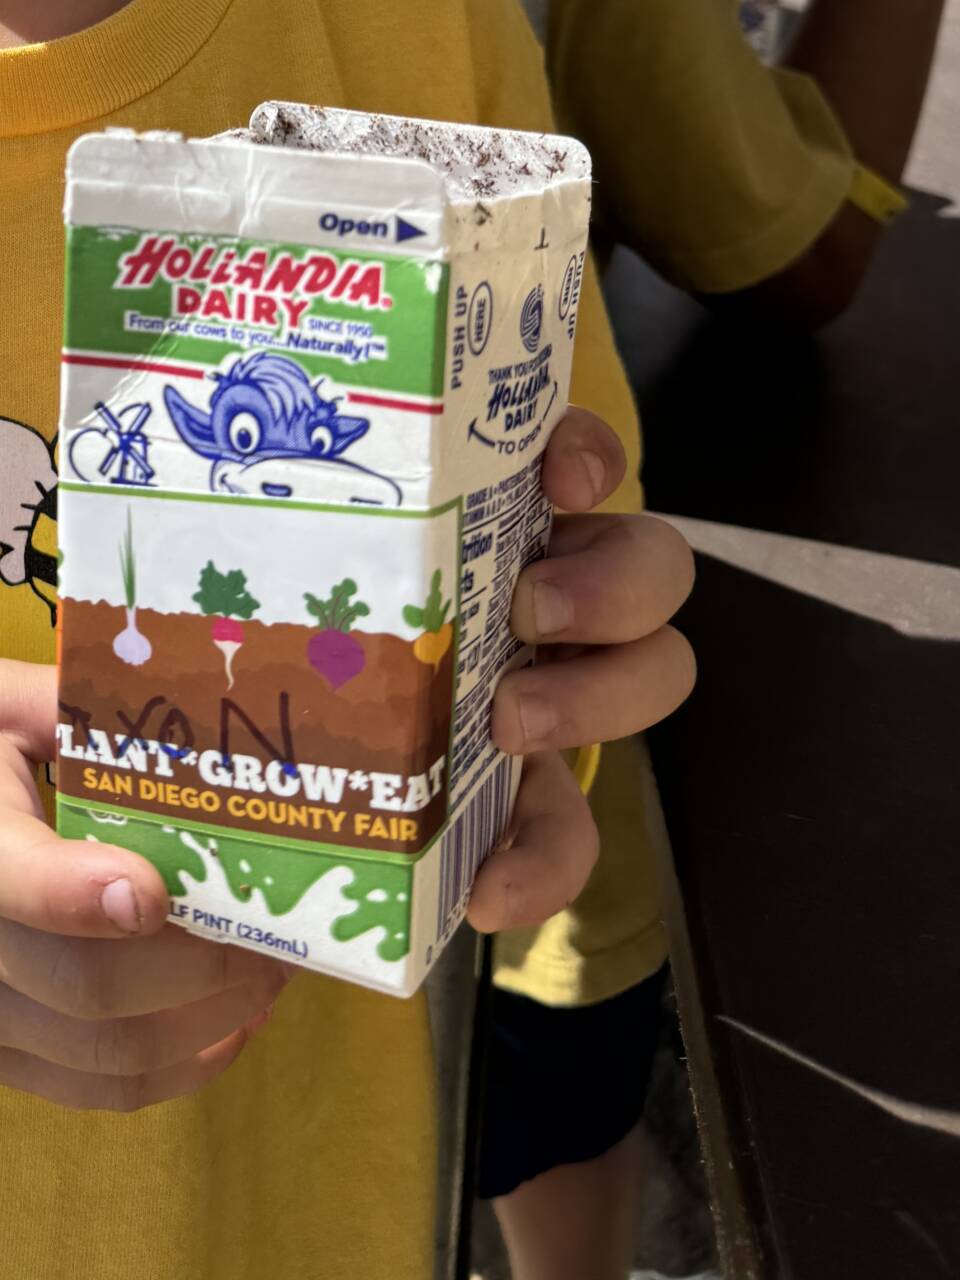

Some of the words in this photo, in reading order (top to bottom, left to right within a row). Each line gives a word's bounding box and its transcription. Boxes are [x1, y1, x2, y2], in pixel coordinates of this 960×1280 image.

[319, 212, 389, 238] Open
[176, 286, 309, 329] DAIRY
[454, 284, 468, 318] UP
[473, 297, 487, 342] HERE
[128, 313, 165, 330] From
[194, 324, 227, 338] cows
[231, 327, 245, 339] to
[308, 318, 342, 334] SINCE
[451, 326, 465, 390] PUSH
[497, 440, 516, 455] TO
[82, 767, 132, 796] SAN
[139, 778, 221, 813] DIEGO
[226, 794, 347, 832] COUNTY
[353, 812, 418, 841] FAIR
[192, 909, 233, 932] PINT
[236, 922, 308, 959] (236mL)
